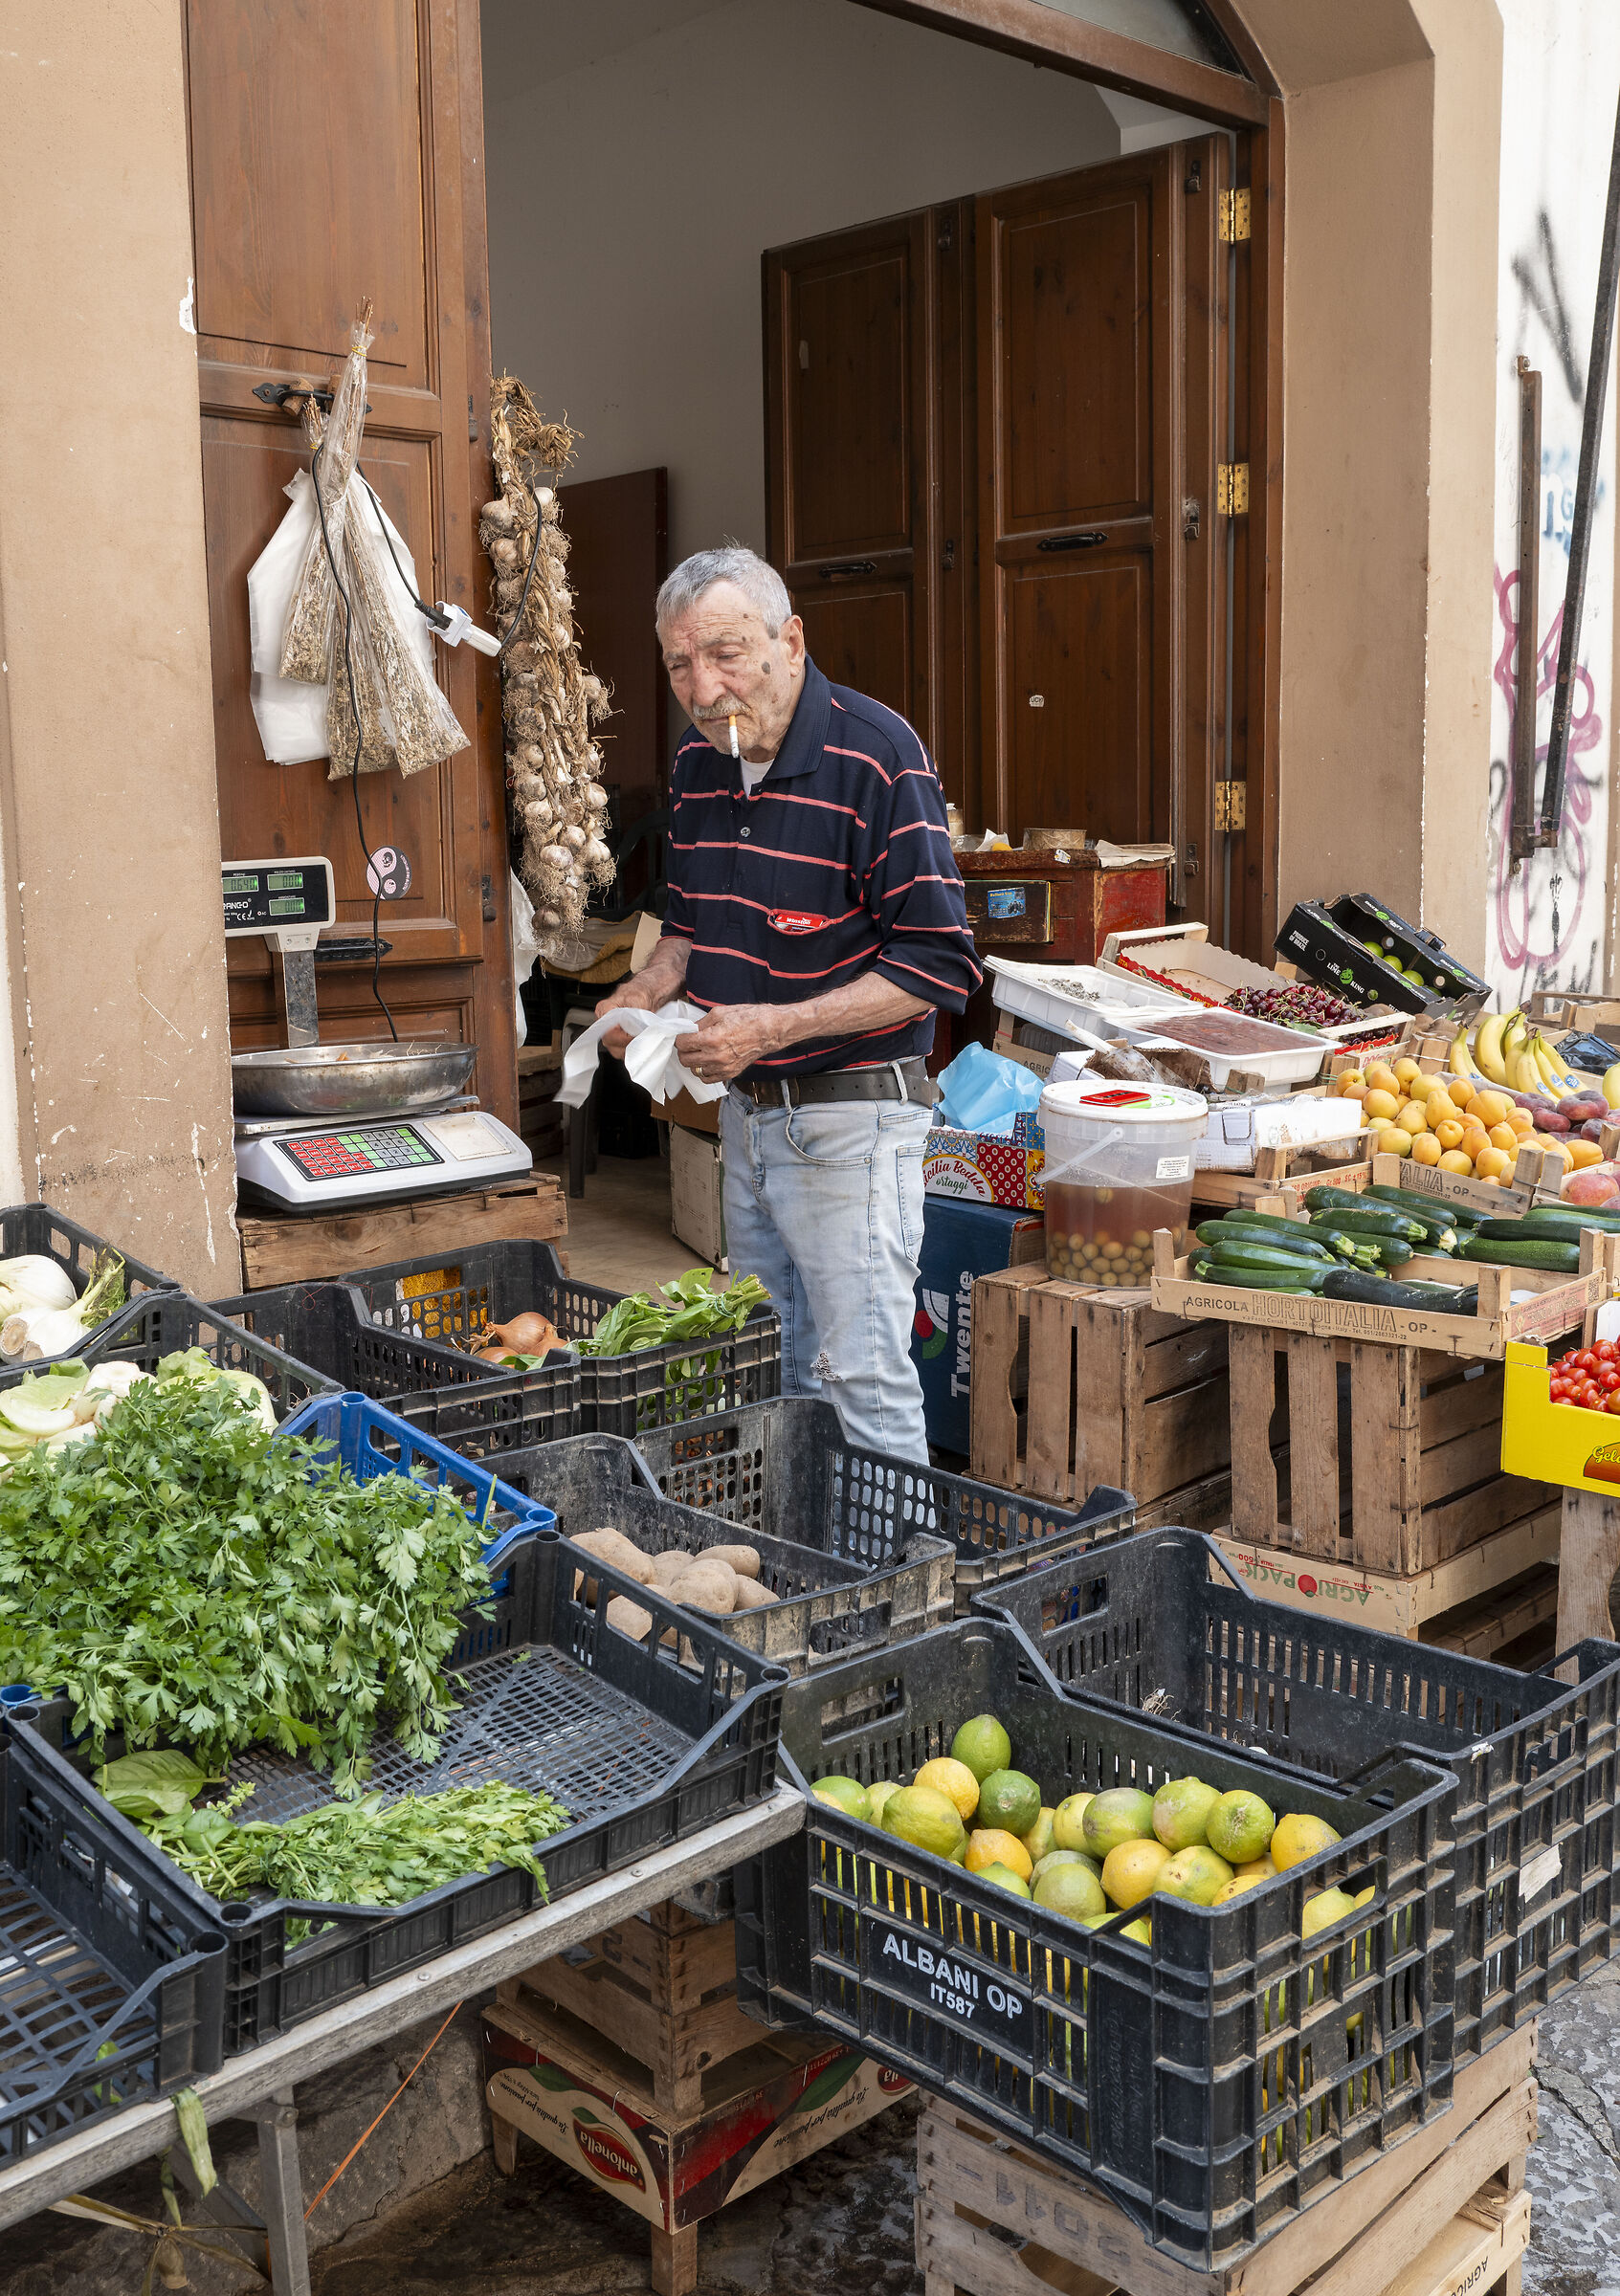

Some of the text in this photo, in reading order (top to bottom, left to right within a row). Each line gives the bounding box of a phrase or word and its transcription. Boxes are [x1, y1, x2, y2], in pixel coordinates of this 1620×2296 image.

[1326, 962, 1342, 976] LIME
[1350, 981, 1365, 994] KING
[936, 1176, 968, 1195] ortaggi
[953, 1160, 986, 1197] Bedda
[1400, 1161, 1470, 1197] ALIA OP
[1187, 1294, 1428, 1334] AGRICOLA HORTOITALIA OP
[951, 1270, 973, 1398] Twente
[1238, 1553, 1254, 1563] 500
[882, 1932, 1023, 2020] ALBANI OP
[930, 1982, 975, 2019] IT587
[499, 2082, 526, 2104] passione
[856, 2087, 869, 2104] La
[526, 2098, 537, 2111] per
[536, 2108, 558, 2124] qualità
[811, 2108, 827, 2126] per
[558, 2122, 570, 2134] La
[580, 2131, 637, 2178] antonella
